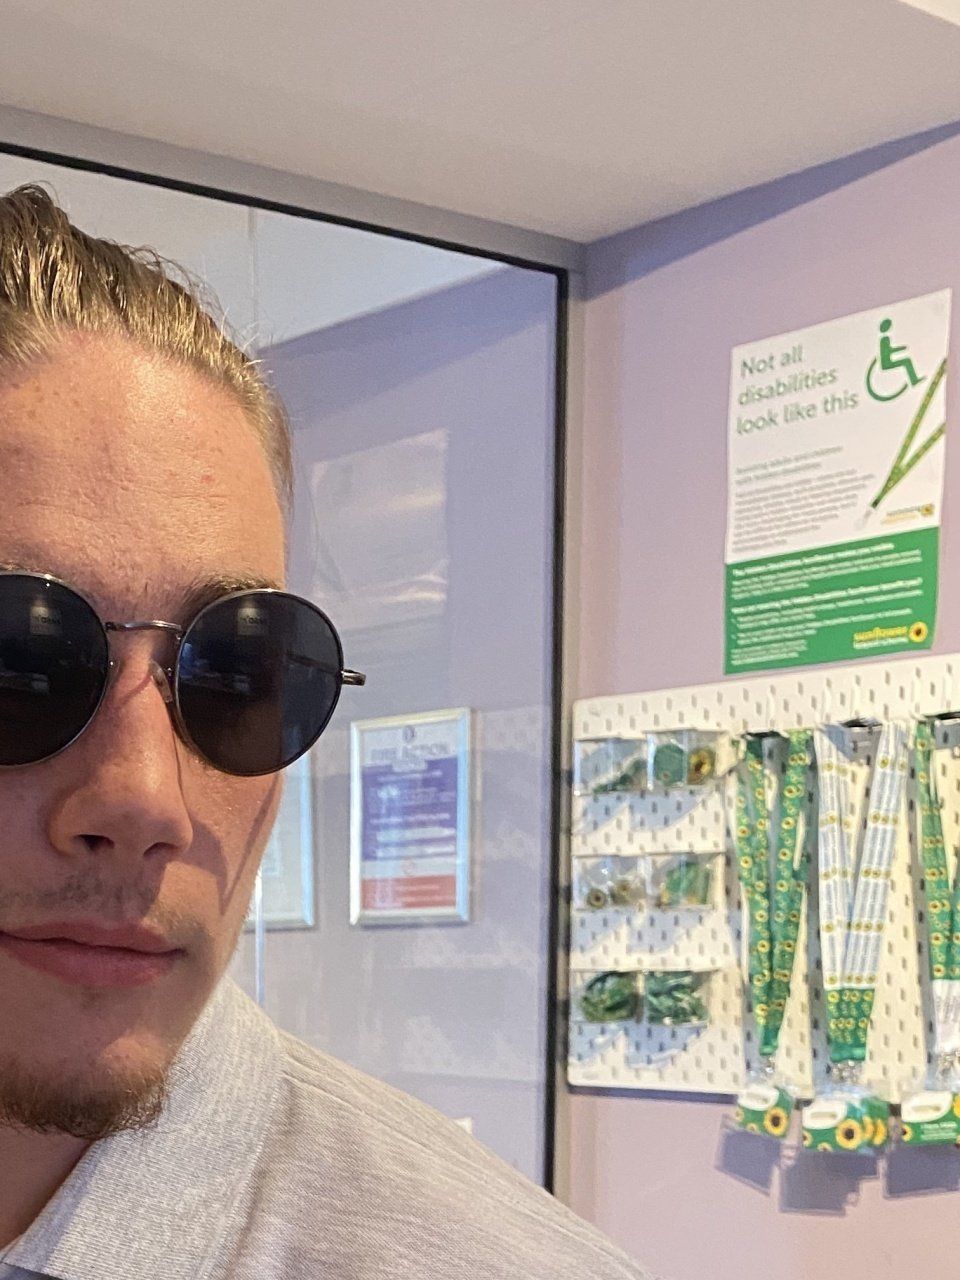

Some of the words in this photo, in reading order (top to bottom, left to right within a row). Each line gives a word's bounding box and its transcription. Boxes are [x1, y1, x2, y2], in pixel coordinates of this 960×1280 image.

[741, 353, 774, 379] Not
[780, 345, 803, 366] all
[738, 368, 838, 406] disabilities
[737, 408, 778, 435] look
[783, 402, 818, 423] like
[823, 390, 858, 413] this
